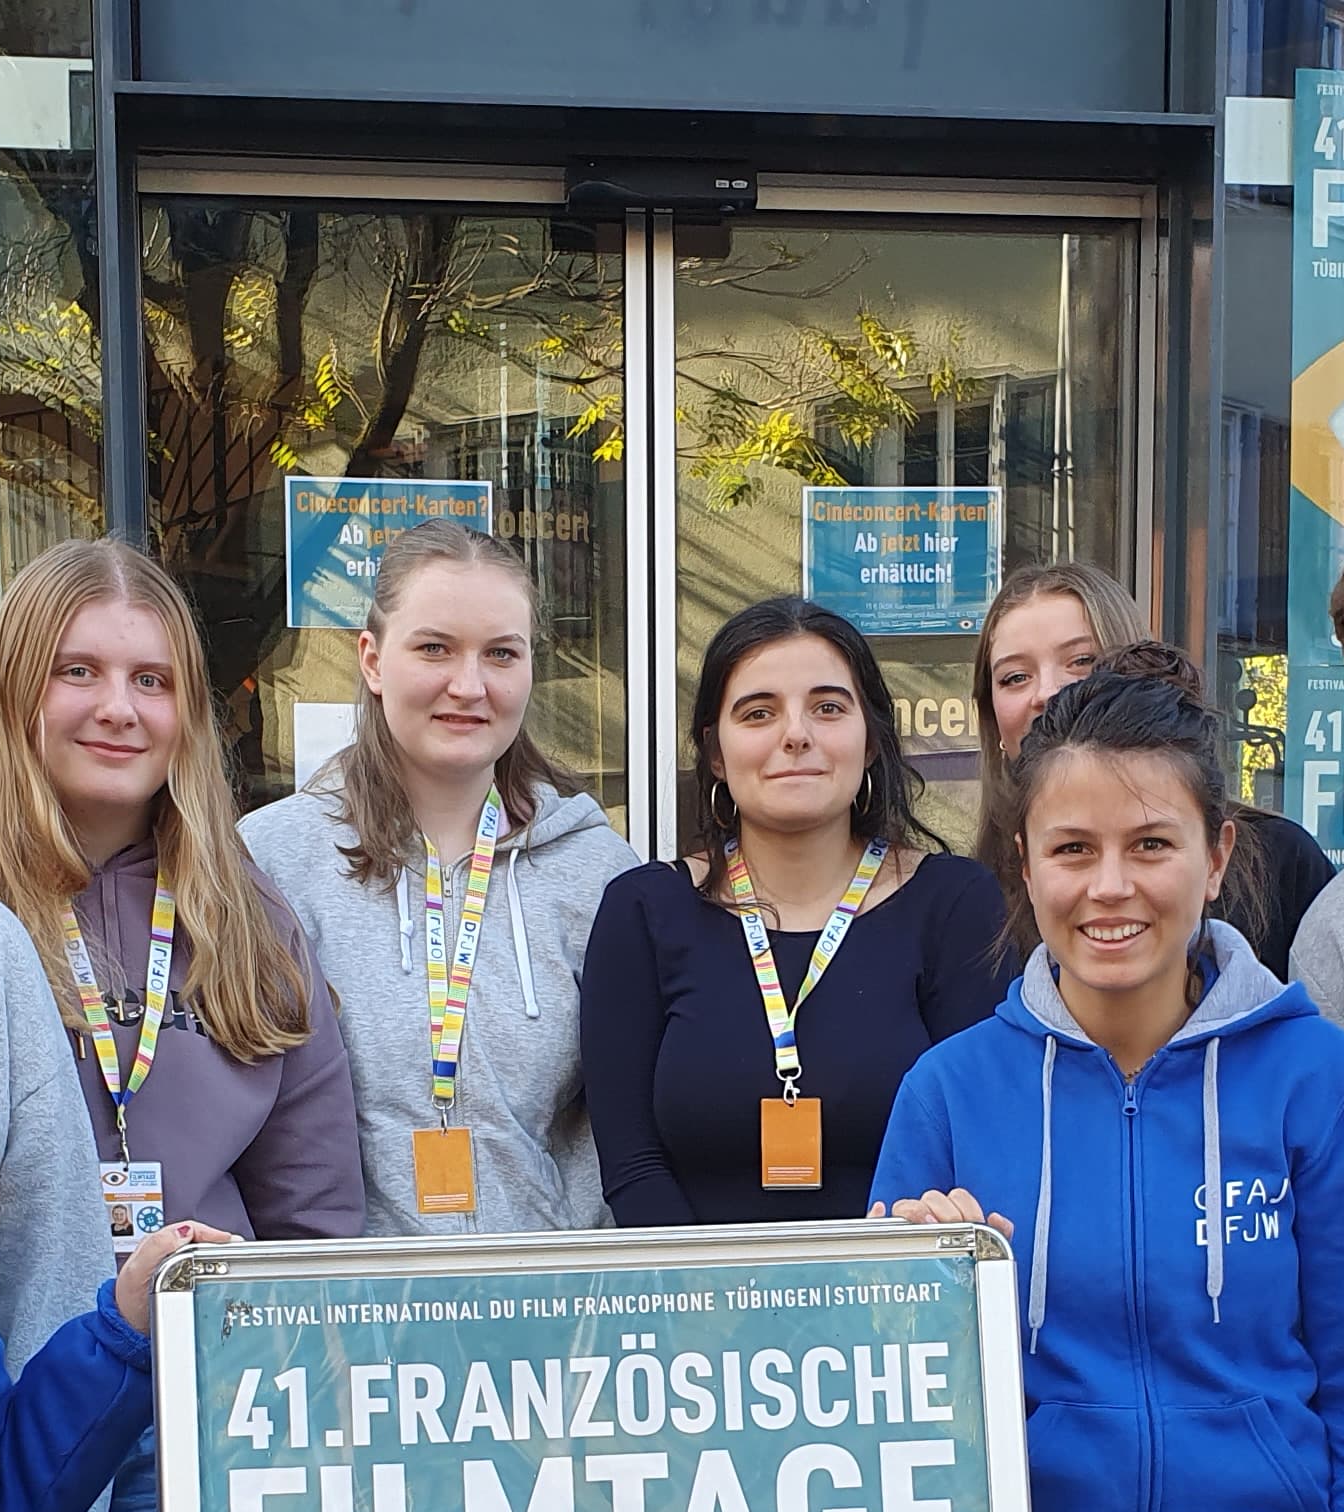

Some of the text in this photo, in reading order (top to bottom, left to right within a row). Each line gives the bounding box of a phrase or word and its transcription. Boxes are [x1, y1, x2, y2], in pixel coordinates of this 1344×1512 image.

[339, 523, 363, 545] Ab
[854, 532, 958, 557] Ab jetzt hier
[860, 563, 952, 584] erhältlich!
[482, 806, 497, 838] OFAJ
[430, 916, 443, 960] OFAJ
[458, 922, 477, 965] DFJW
[746, 915, 765, 951] DFJW
[821, 916, 847, 953] OFAJ
[67, 940, 92, 985] DFJW
[151, 947, 167, 991] OFAJ
[326, 1297, 484, 1325] INTERNATIONAL
[488, 1295, 518, 1321] DU
[522, 1294, 567, 1320] FILM
[572, 1291, 716, 1318] FRANCOPHONE
[227, 1334, 953, 1450] 41.FRANZÖSISCHE
